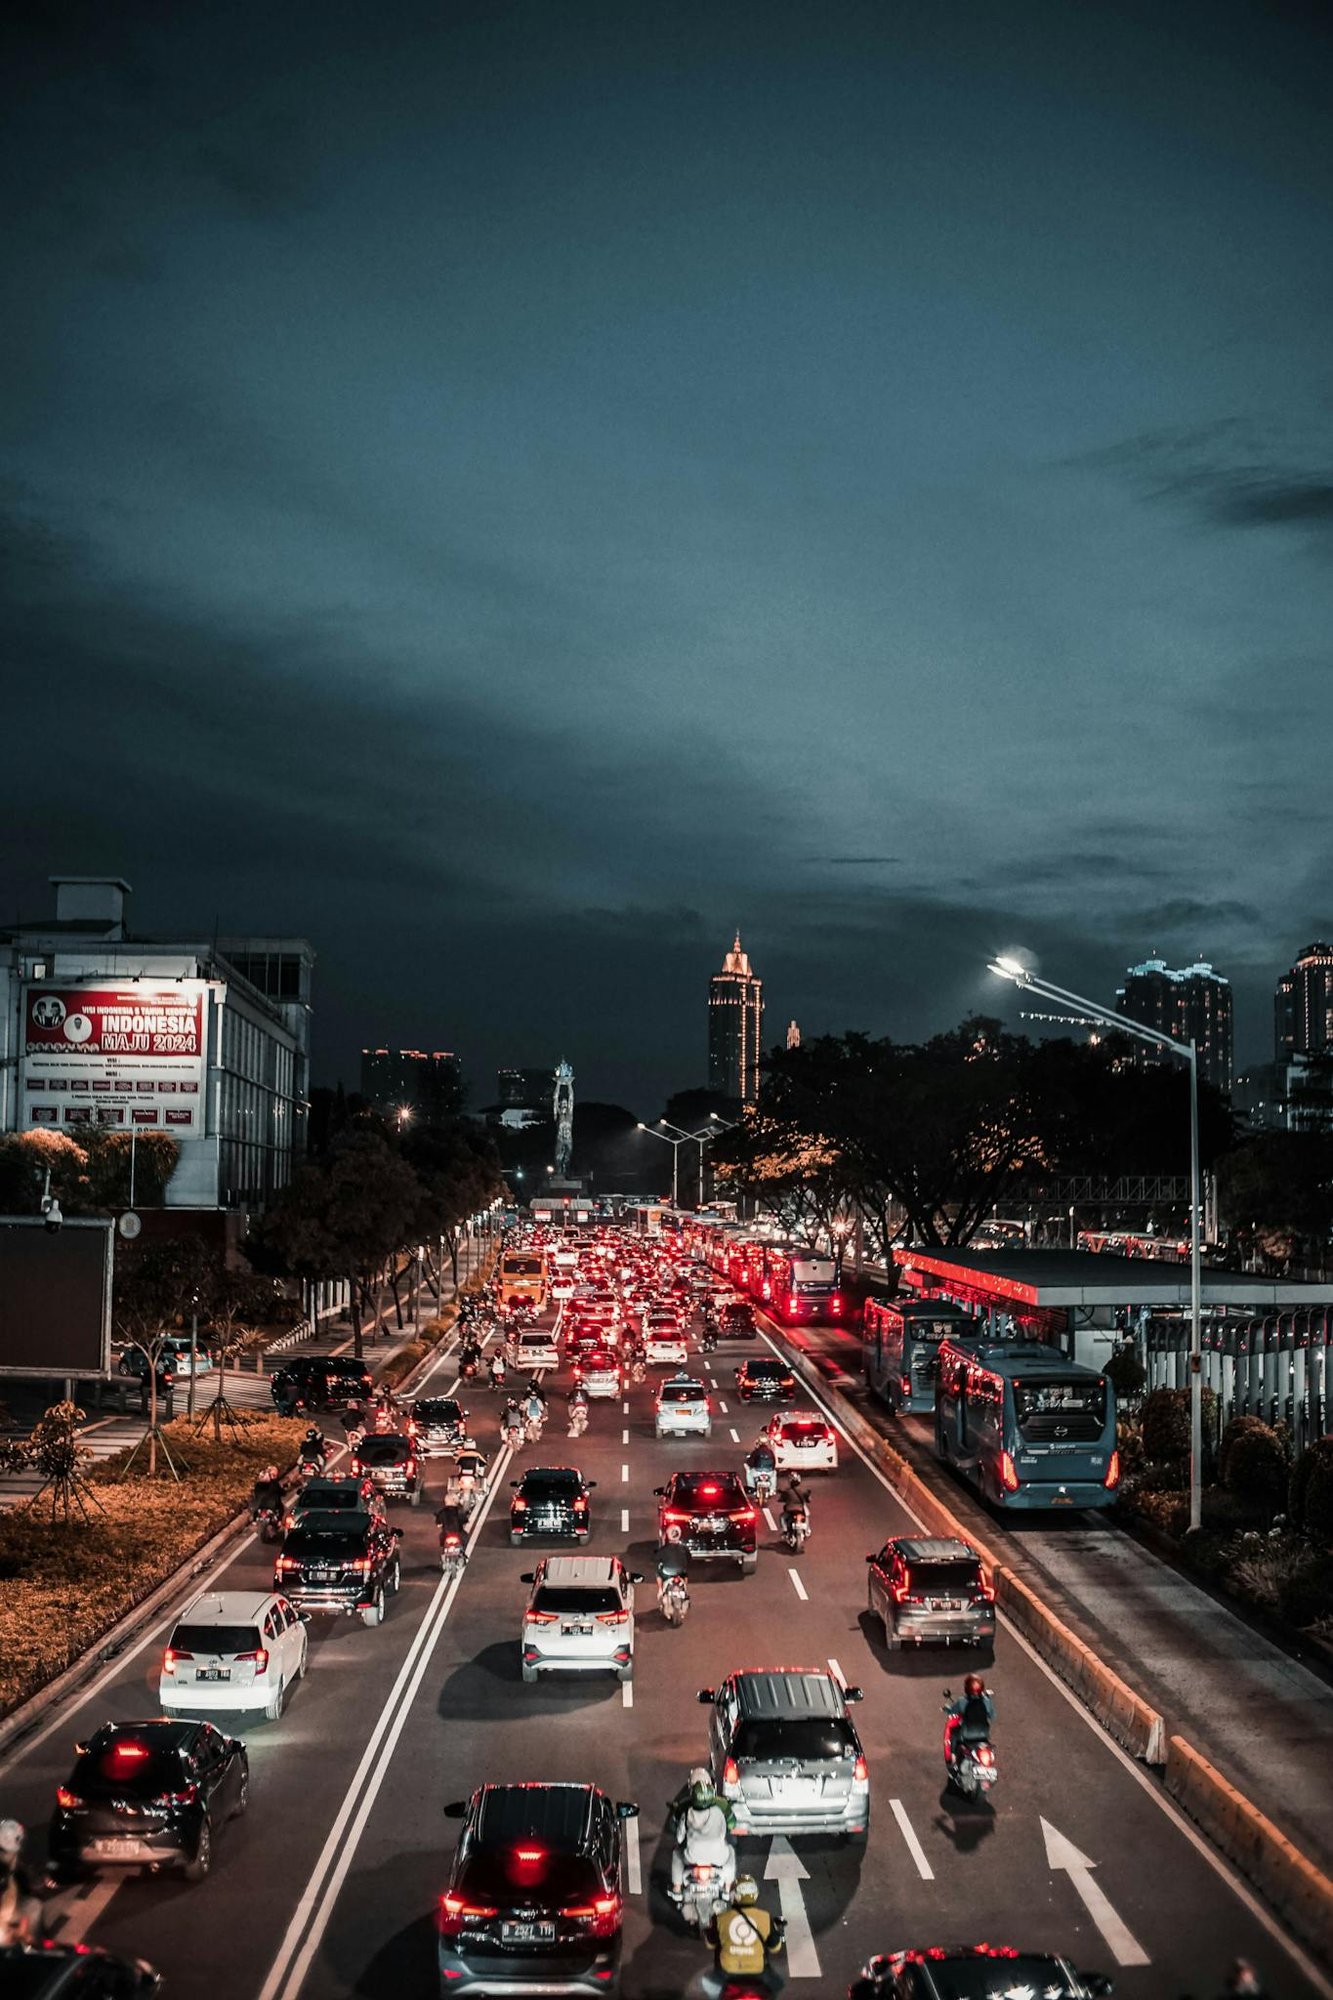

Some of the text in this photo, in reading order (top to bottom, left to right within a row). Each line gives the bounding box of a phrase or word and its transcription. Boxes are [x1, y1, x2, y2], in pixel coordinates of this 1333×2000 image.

[82, 1006, 96, 1014] VISI
[97, 1006, 133, 1015] INDONESIA
[141, 1007, 164, 1016] TAHUN
[102, 1015, 196, 1034] INDONESIA
[101, 1033, 197, 1052] MAJU 2024
